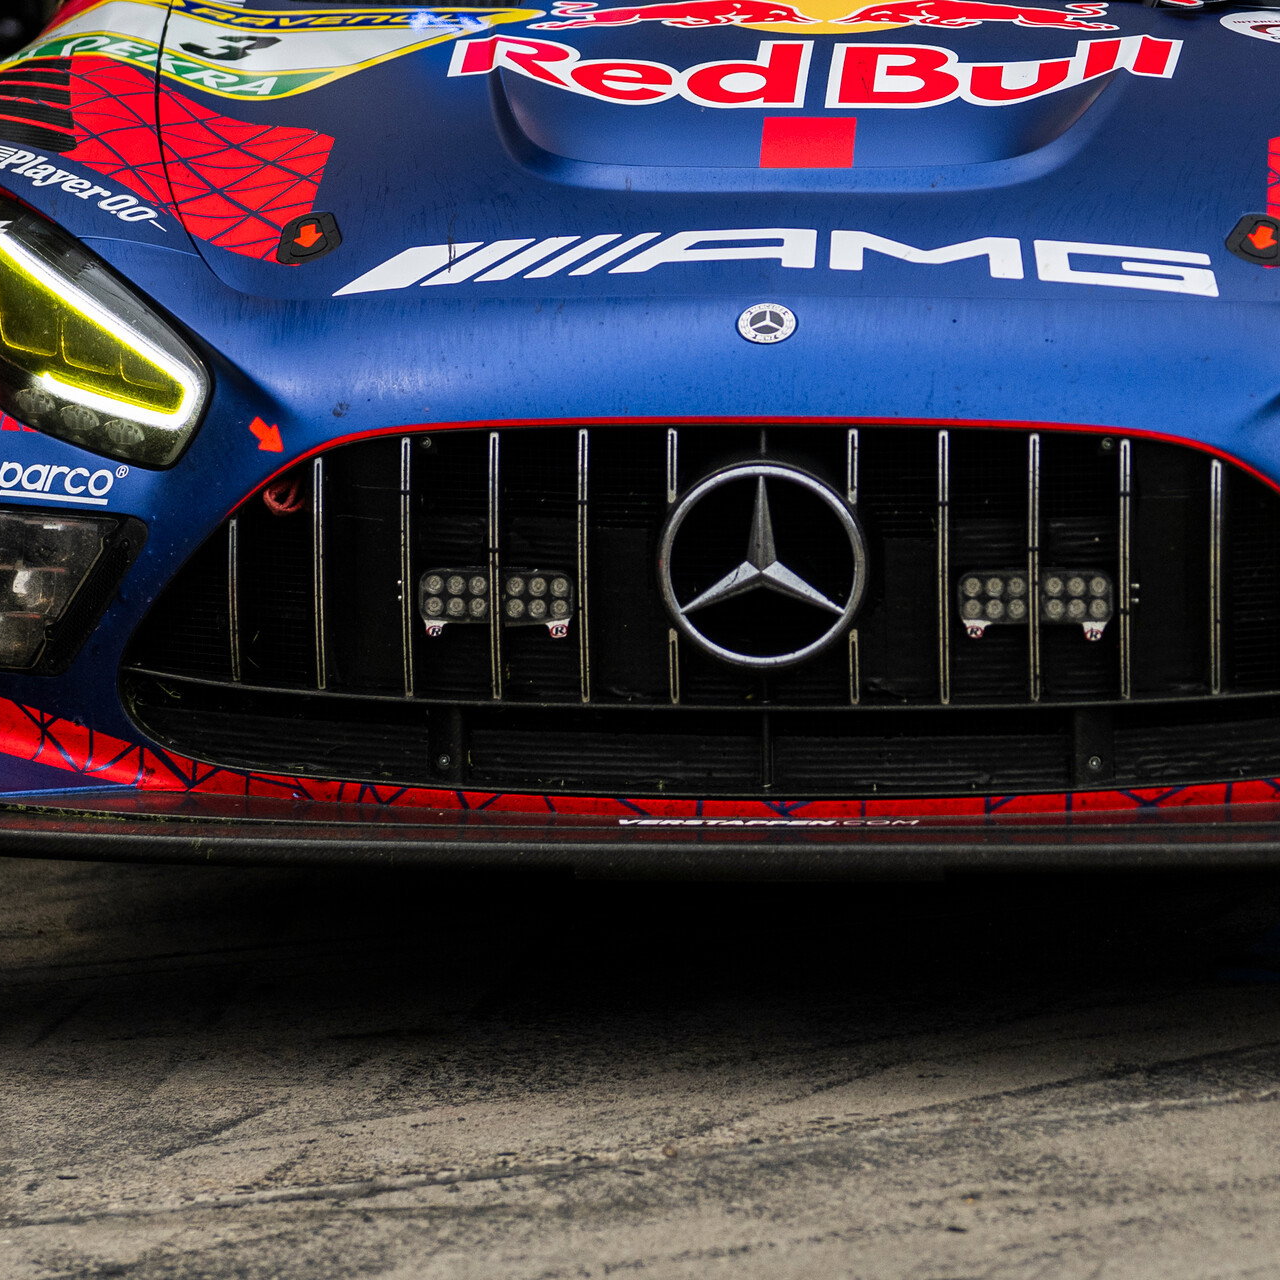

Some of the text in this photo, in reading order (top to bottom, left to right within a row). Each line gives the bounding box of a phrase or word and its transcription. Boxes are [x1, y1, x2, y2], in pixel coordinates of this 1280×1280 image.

[448, 33, 1183, 109] Red Bull
[610, 228, 1218, 298] AMG
